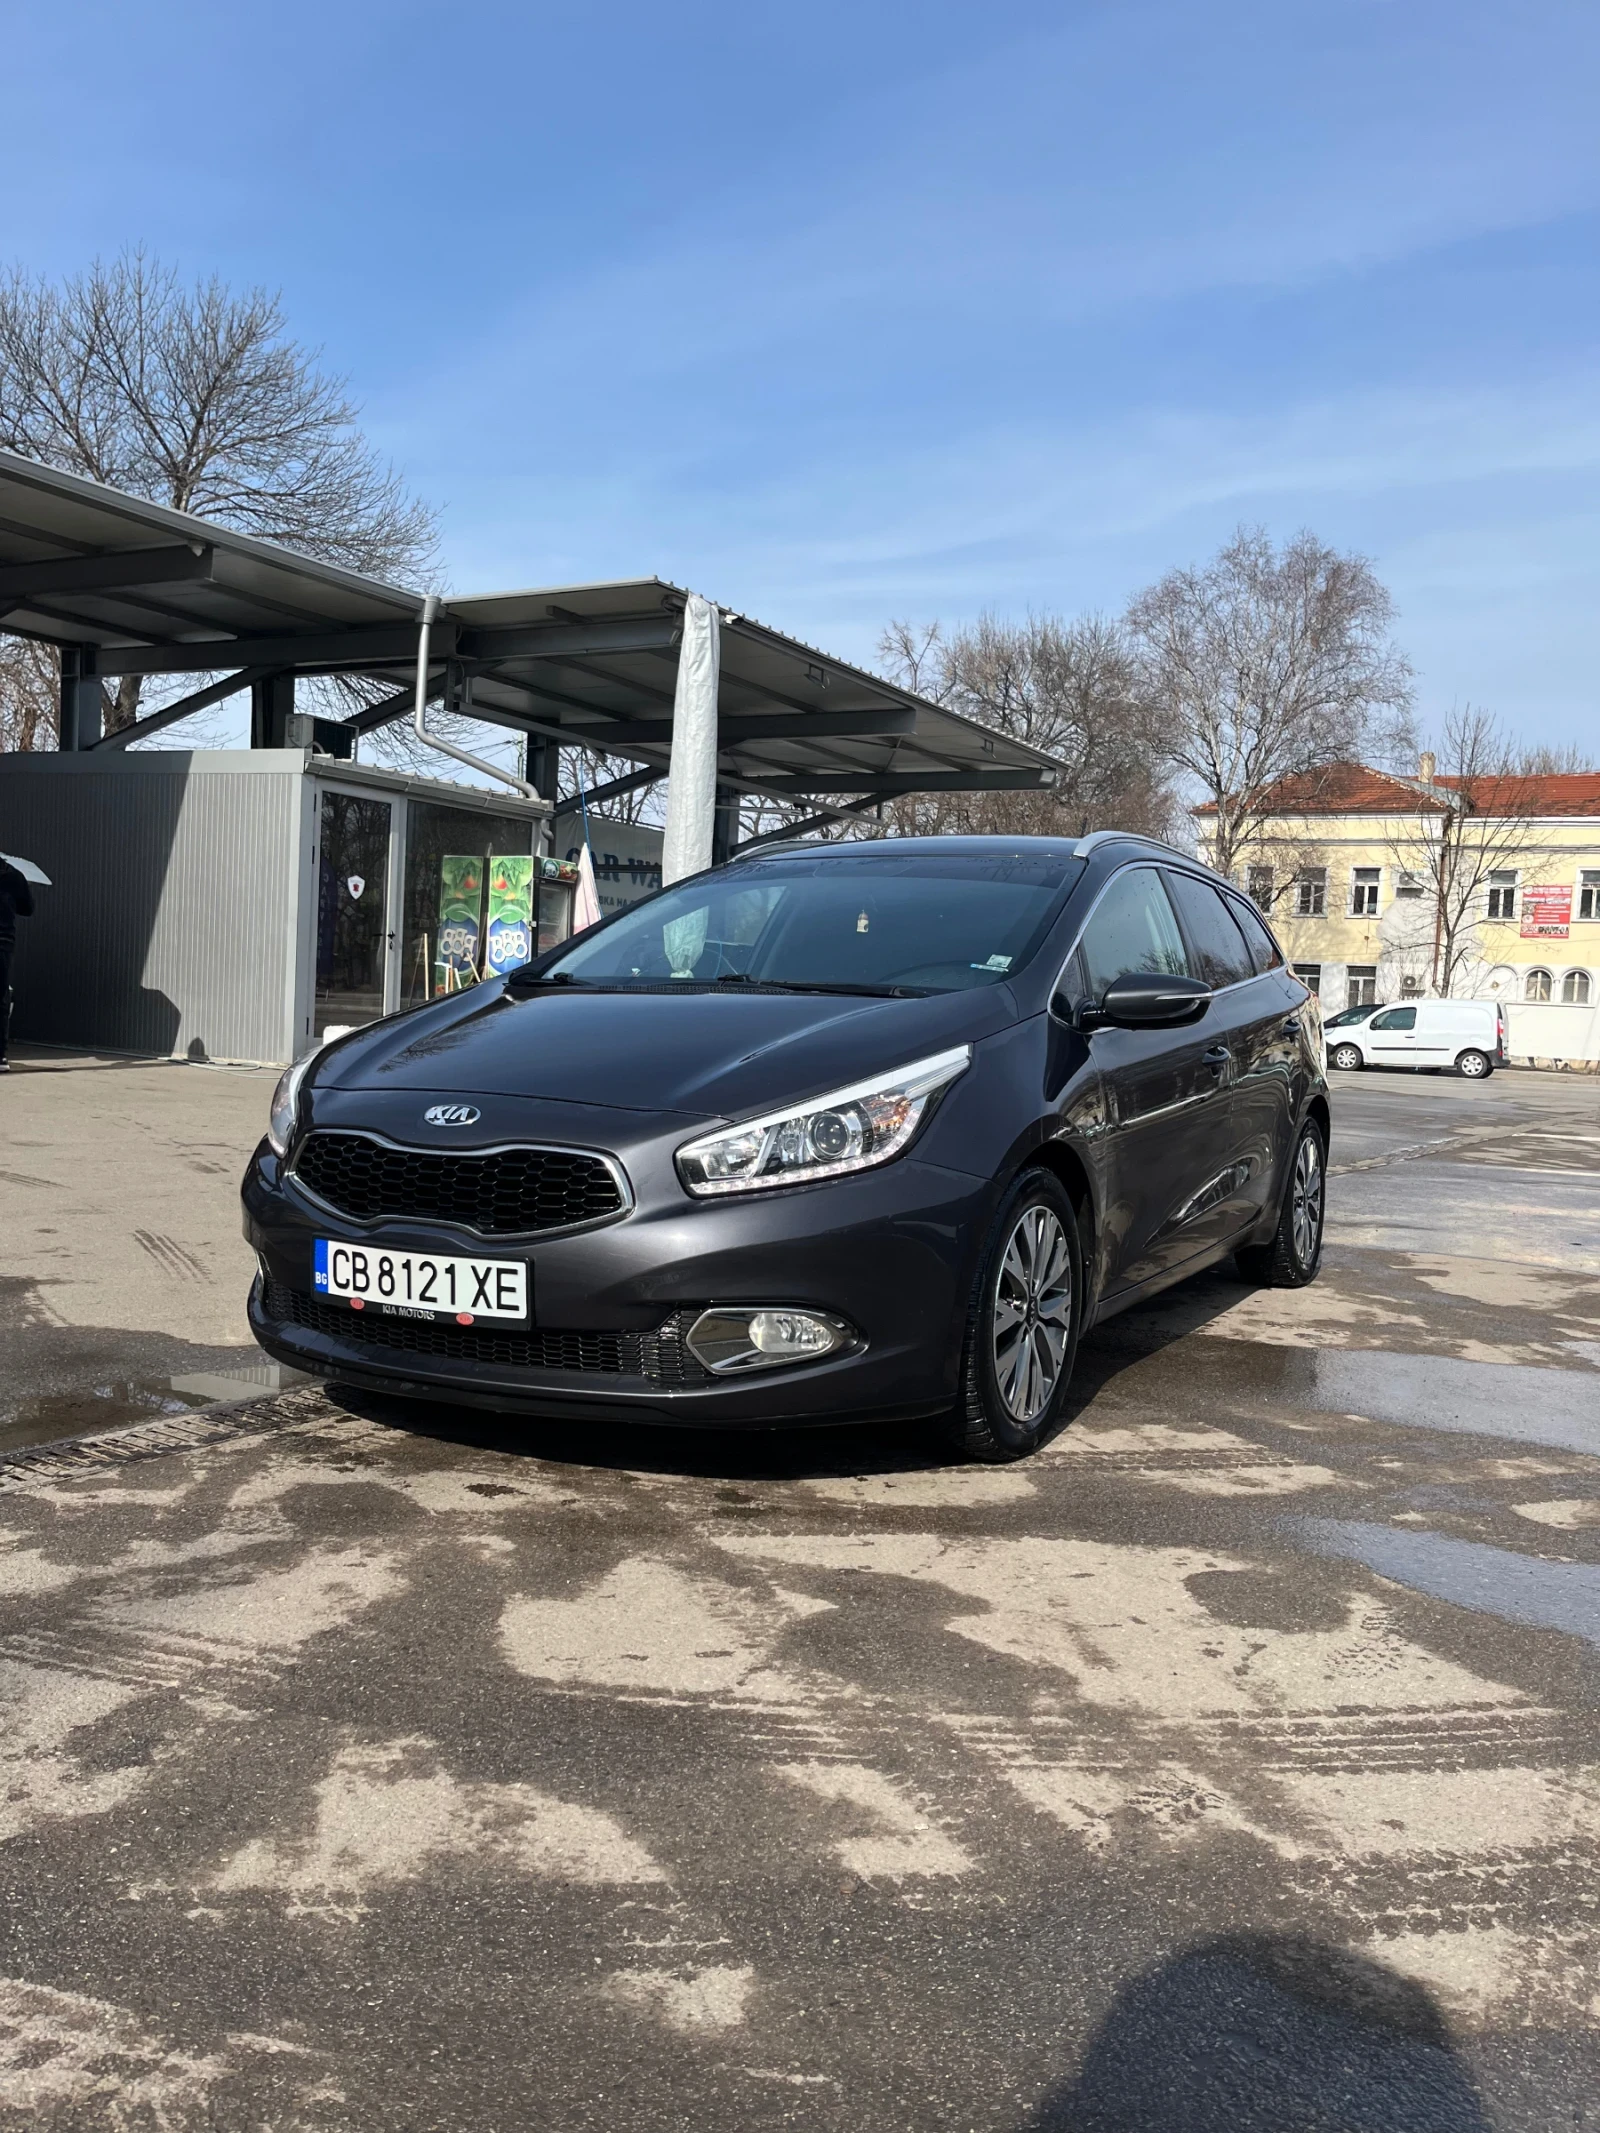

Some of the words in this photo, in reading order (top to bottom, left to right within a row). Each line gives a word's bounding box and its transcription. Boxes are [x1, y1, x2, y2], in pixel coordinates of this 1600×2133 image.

[490, 929, 528, 963] BBB
[426, 1105, 470, 1121] KIA
[315, 1271, 327, 1285] BG
[332, 1248, 370, 1293] CB
[378, 1256, 456, 1305] 8121
[470, 1264, 520, 1311] XE
[382, 1304, 397, 1315] KIA
[398, 1306, 435, 1320] MOTORS
